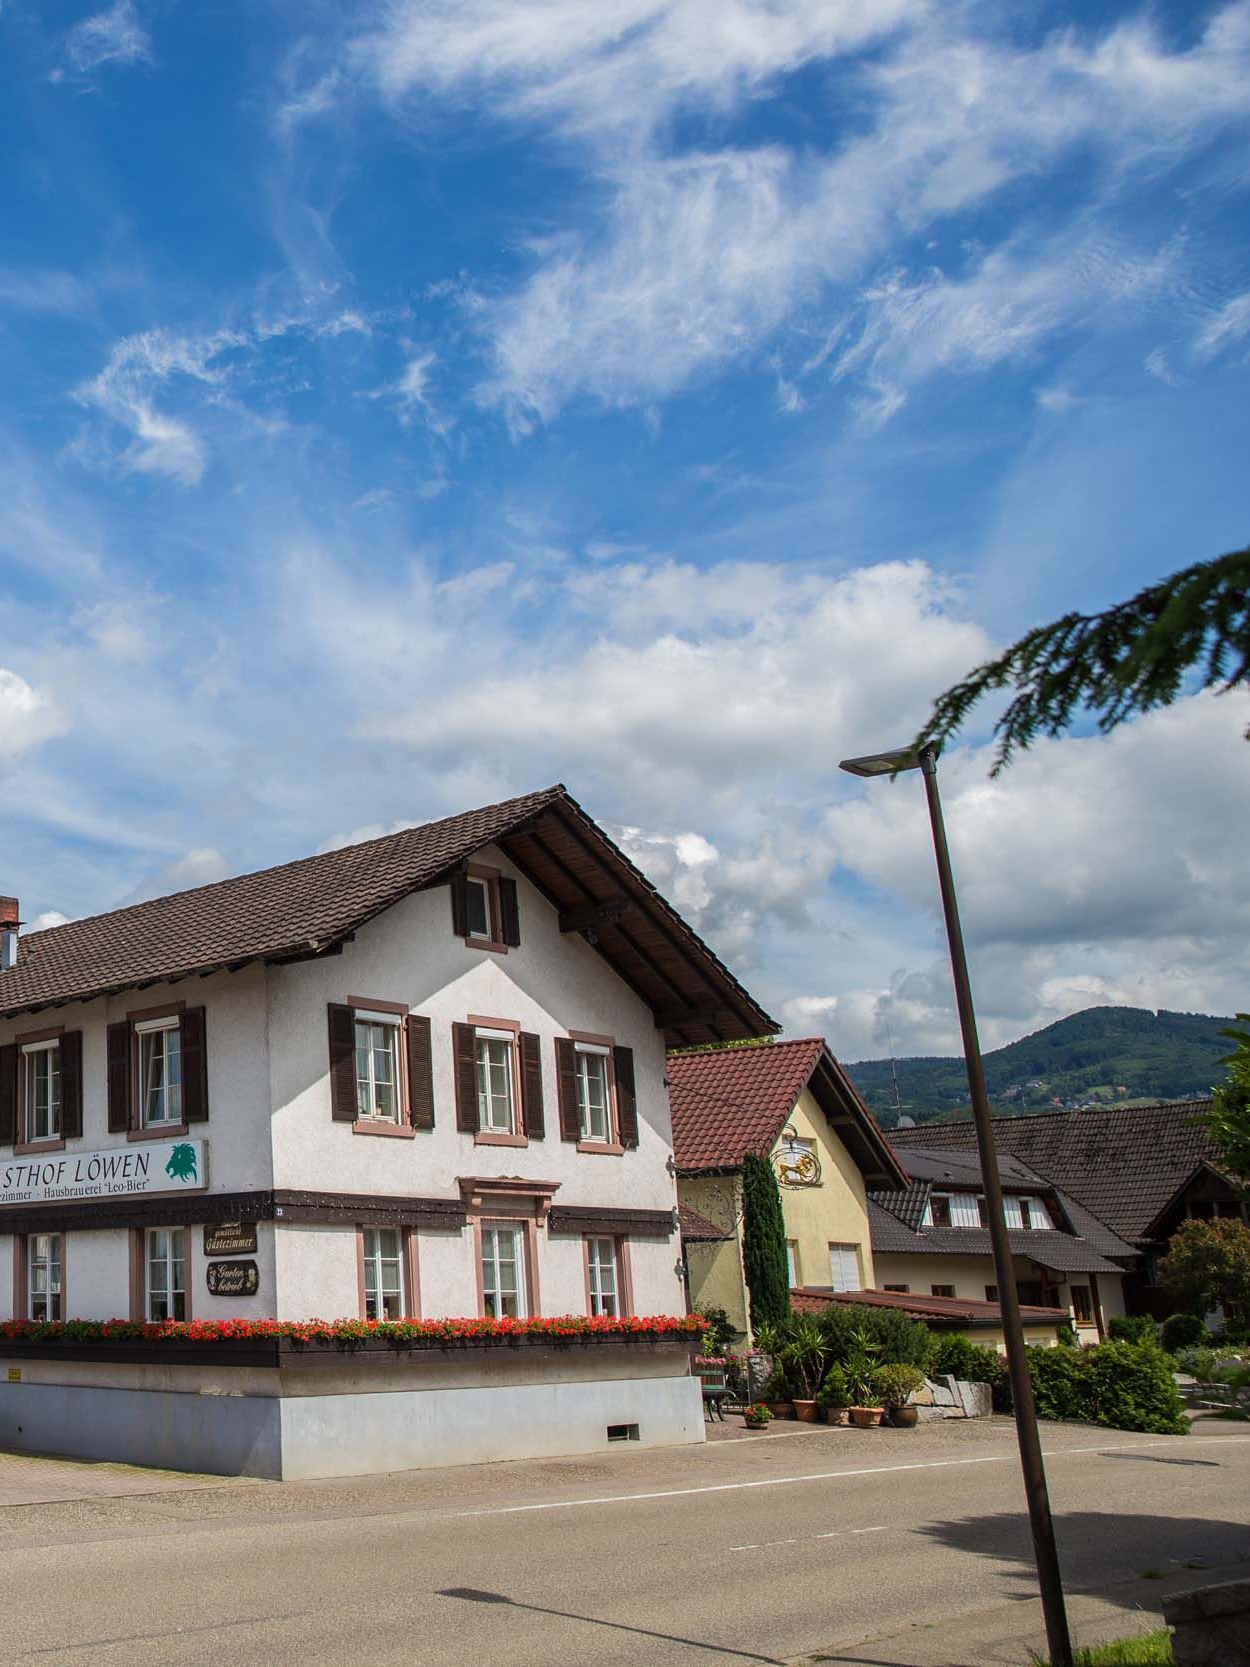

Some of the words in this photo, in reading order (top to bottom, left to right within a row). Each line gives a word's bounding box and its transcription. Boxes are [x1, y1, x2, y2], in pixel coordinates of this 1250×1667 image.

[75, 1152, 150, 1182] LÖWEN
[44, 1183, 102, 1198] Hausbrauerei
[206, 1237, 253, 1250] Gästezimmer
